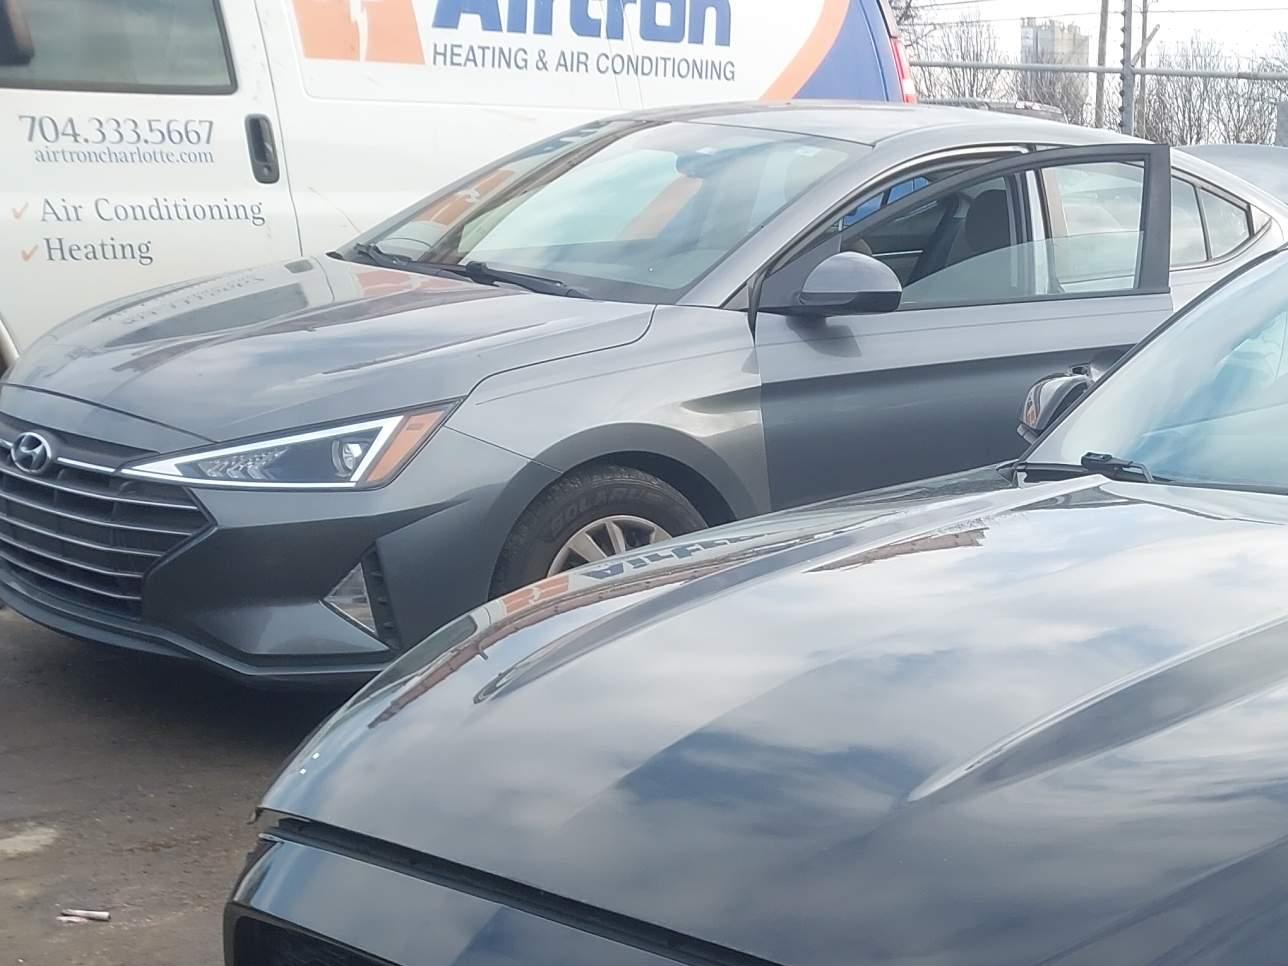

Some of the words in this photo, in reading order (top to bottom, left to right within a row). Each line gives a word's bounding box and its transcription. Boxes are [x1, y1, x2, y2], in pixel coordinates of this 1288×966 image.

[432, 43, 528, 70] HEATING
[535, 50, 549, 71] &
[555, 51, 589, 73] AIR
[596, 54, 735, 81] CONDITIONING
[18, 115, 214, 145] 704.333.5667
[35, 146, 214, 164] airtroncharlotte.com
[41, 198, 83, 222] Air
[94, 198, 266, 226] Conditioning
[44, 236, 153, 265] Heating
